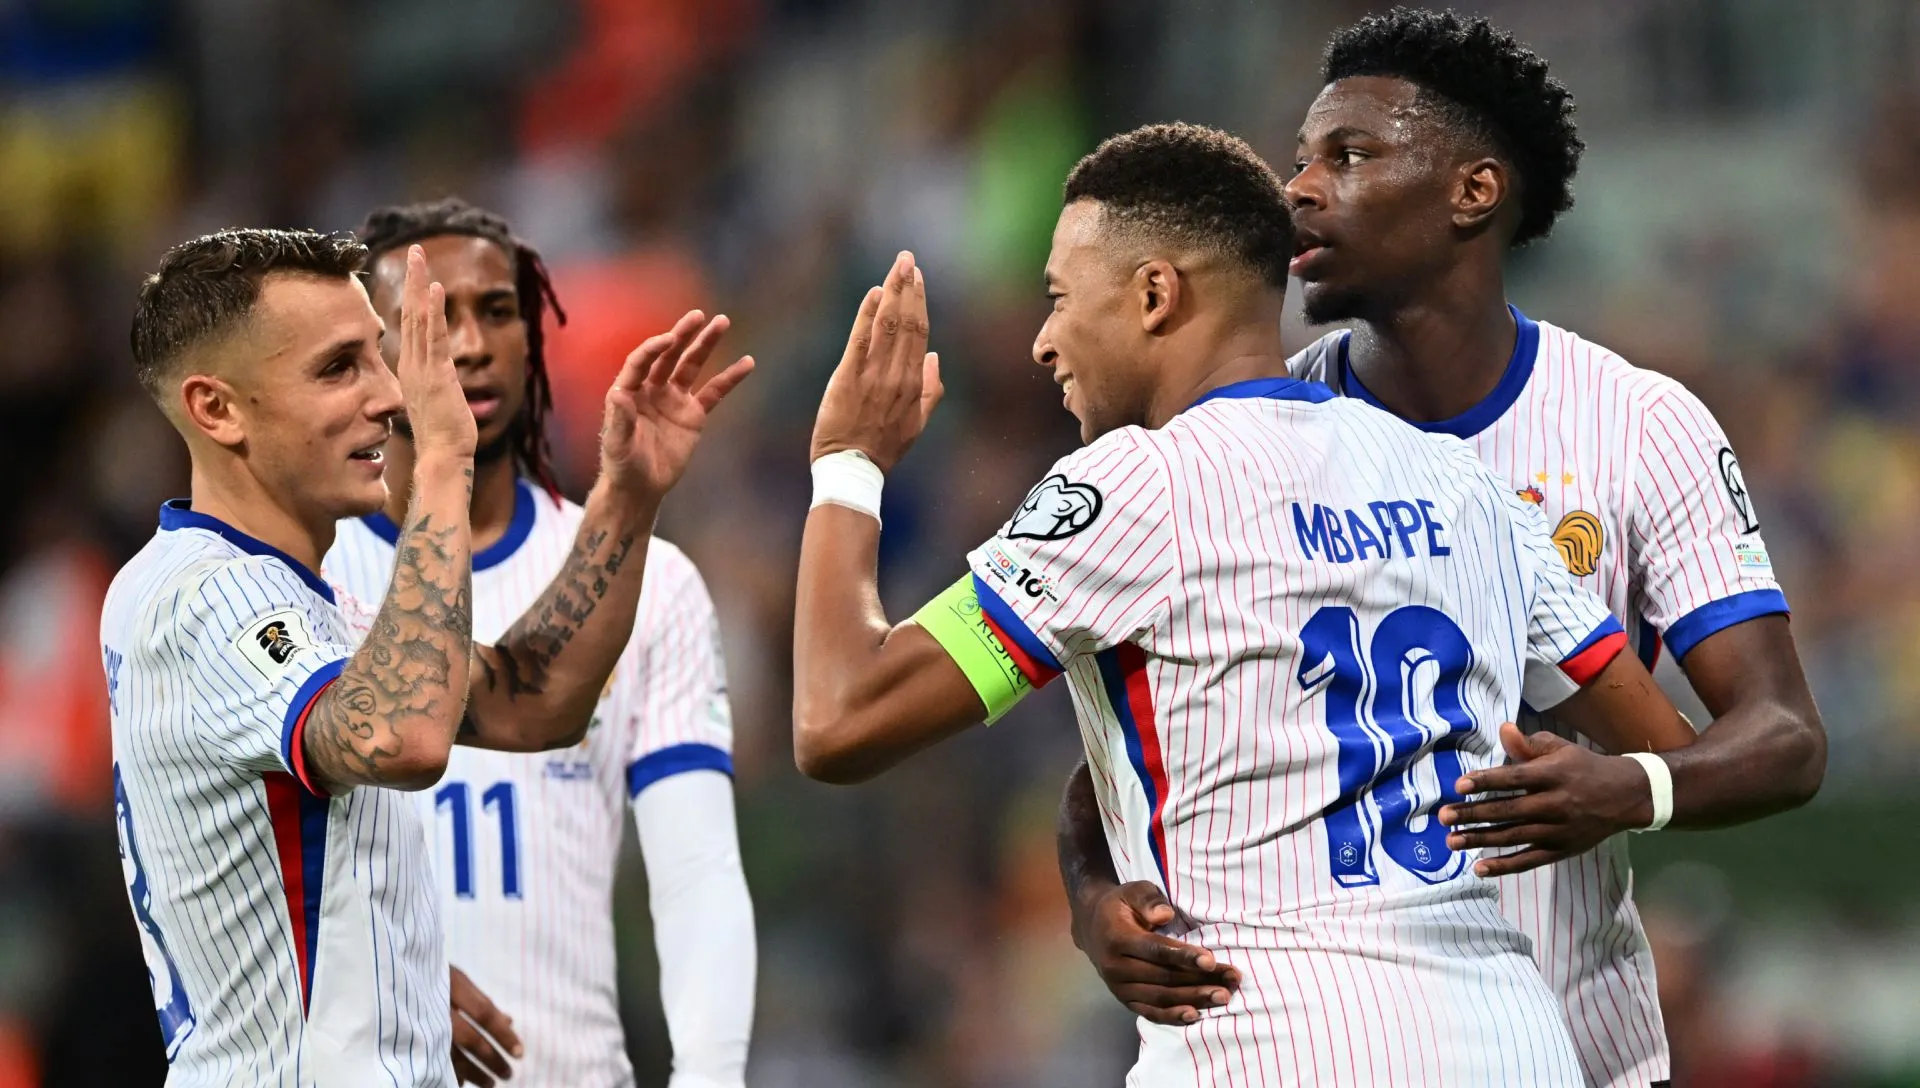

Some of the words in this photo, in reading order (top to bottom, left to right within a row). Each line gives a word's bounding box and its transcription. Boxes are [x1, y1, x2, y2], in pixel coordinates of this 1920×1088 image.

[1291, 498, 1451, 563] MBAPPE
[1295, 604, 1479, 888] 10
[434, 781, 523, 899] 11
